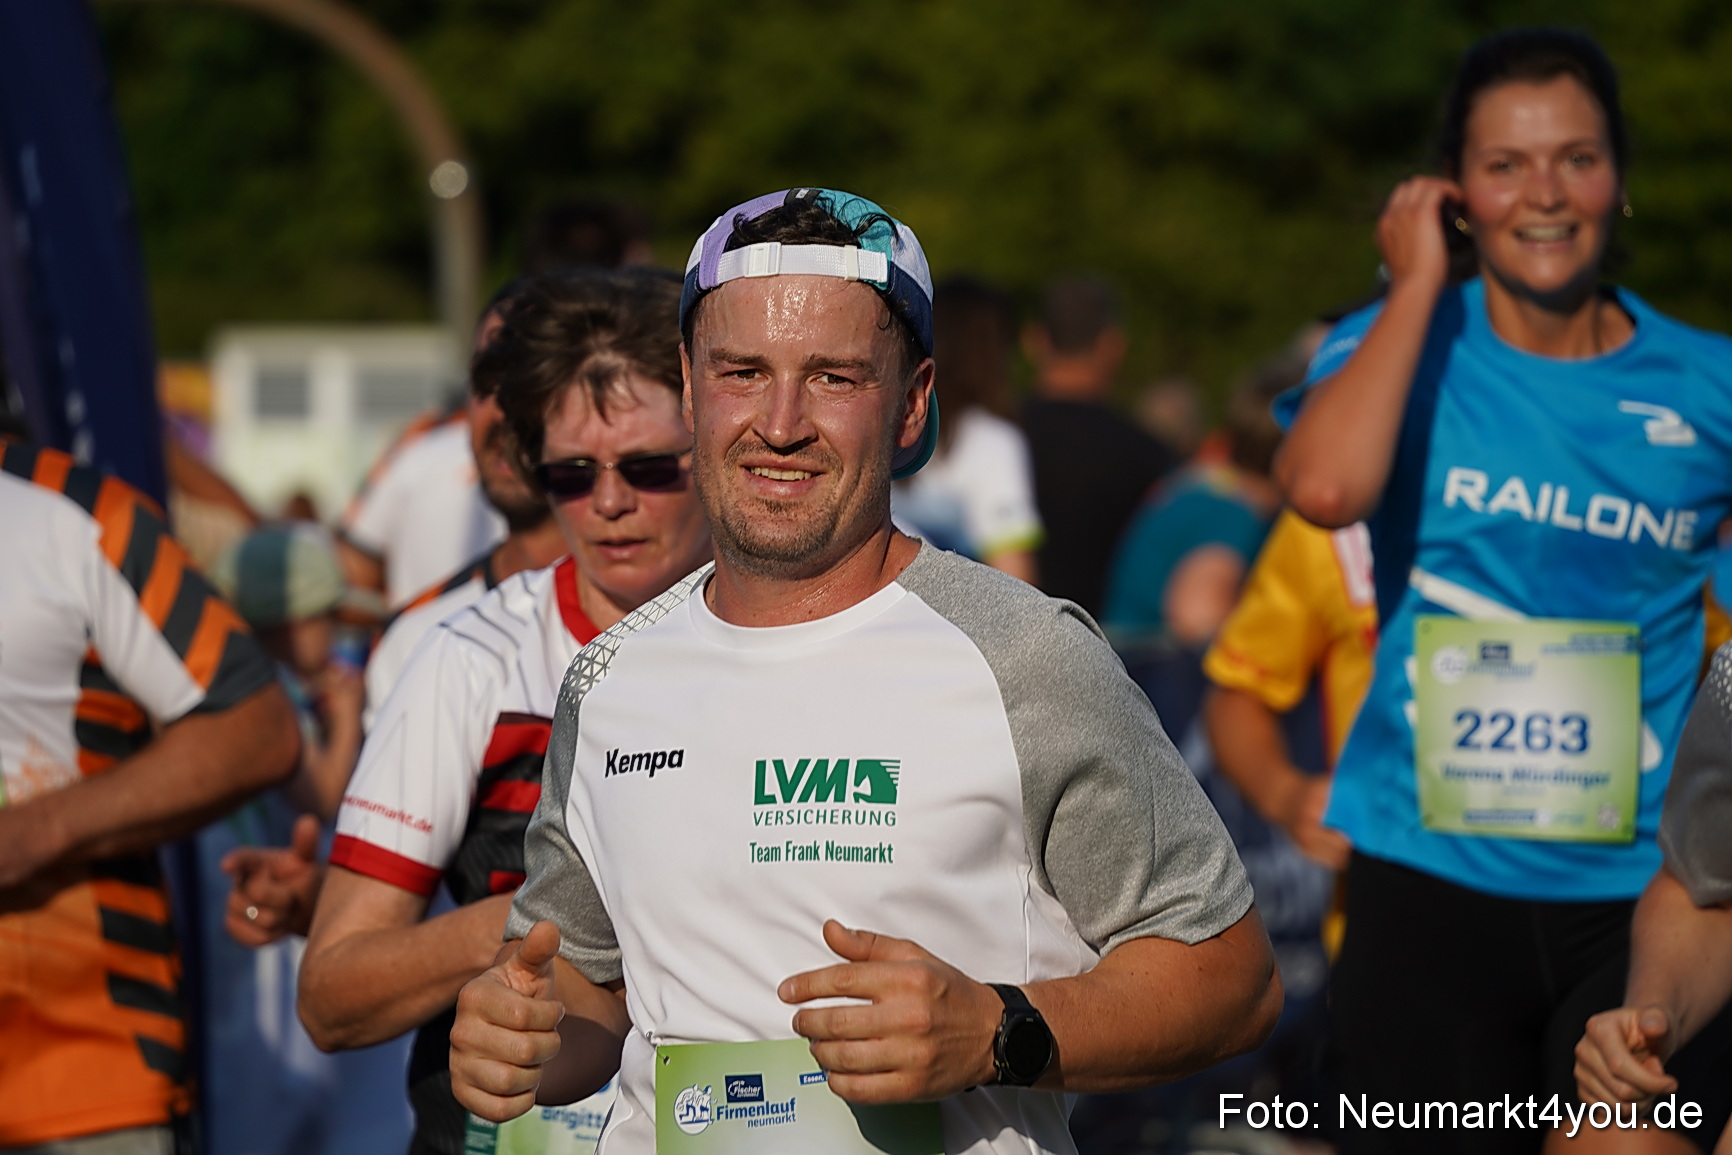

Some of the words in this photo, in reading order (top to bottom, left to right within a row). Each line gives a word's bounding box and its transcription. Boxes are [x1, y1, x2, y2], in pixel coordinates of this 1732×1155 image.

[1443, 466, 1699, 551] RAILONE
[1455, 710, 1590, 755] 2263
[604, 748, 685, 778] Kempa
[753, 758, 850, 805] LVM
[753, 809, 897, 827] VERSICHERUNG
[749, 841, 782, 863] Team
[785, 840, 821, 862] Frank
[824, 840, 894, 863] Neumarkt
[541, 1106, 604, 1129] Brigitt
[716, 1097, 797, 1121] Firmenlauf
[747, 1113, 797, 1128] neumarkt
